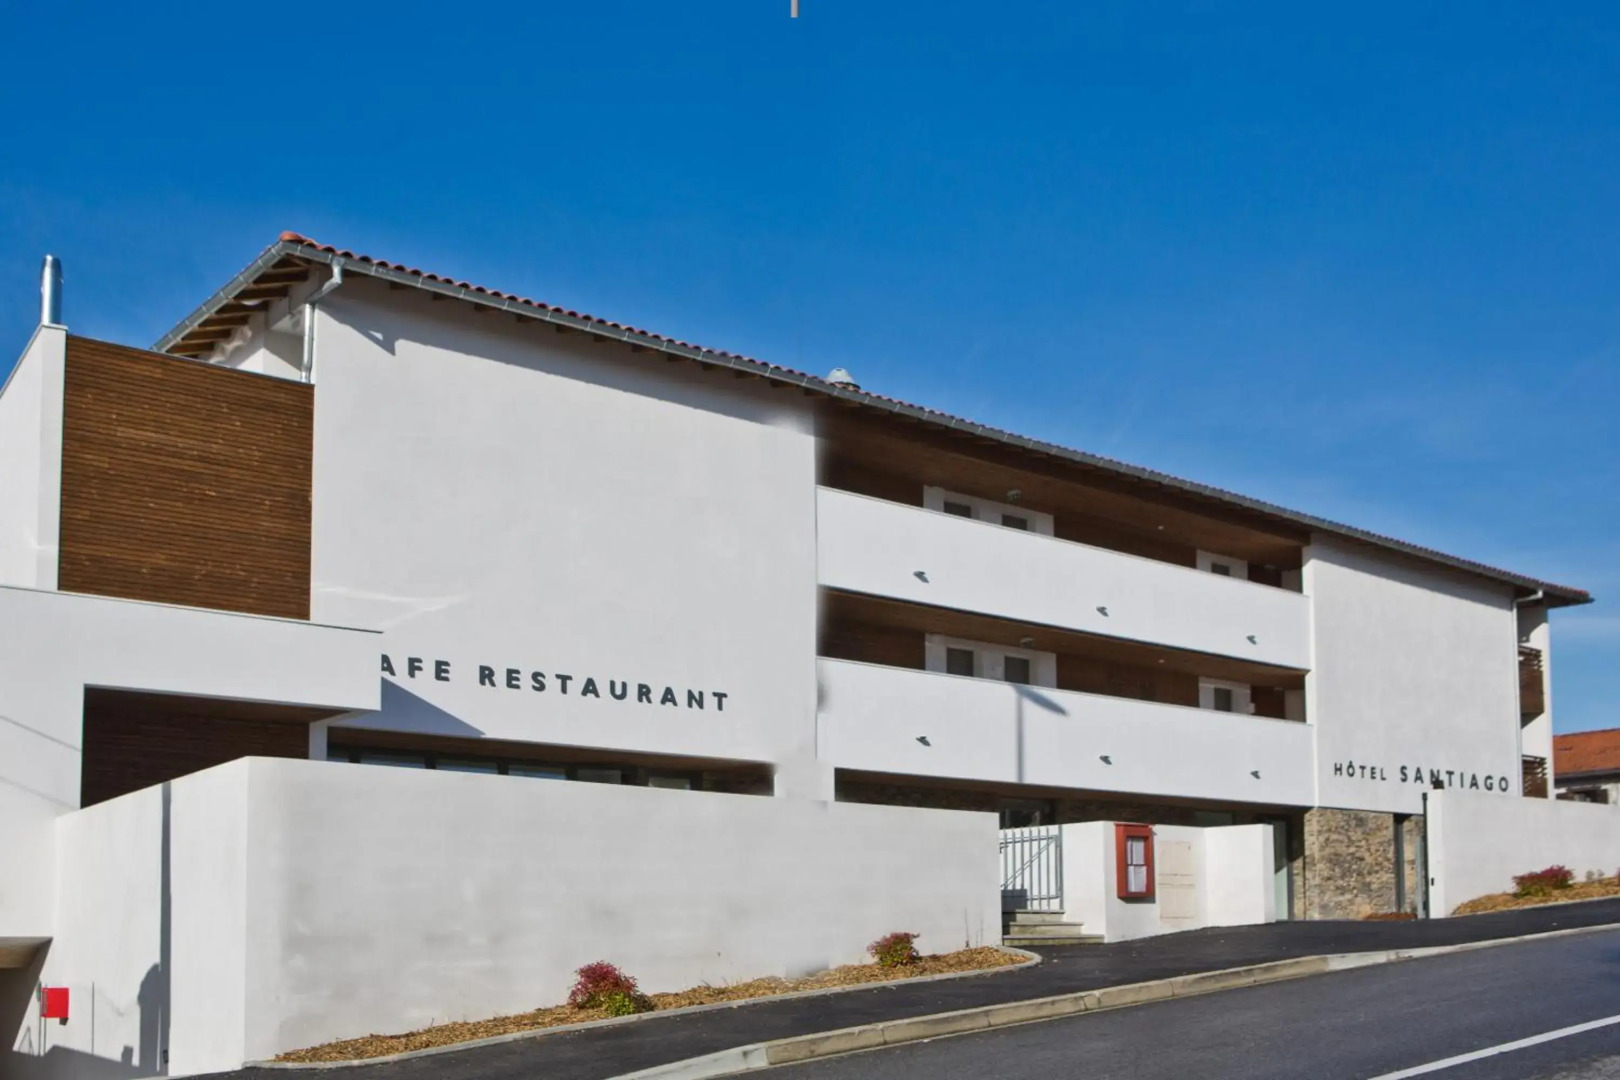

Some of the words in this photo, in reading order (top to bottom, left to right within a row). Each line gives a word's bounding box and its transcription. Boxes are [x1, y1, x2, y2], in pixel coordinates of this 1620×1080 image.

[479, 665, 728, 711] RESTAURANT
[1334, 760, 1387, 781] HÔTEL
[1400, 765, 1509, 792] SANTIAGO
